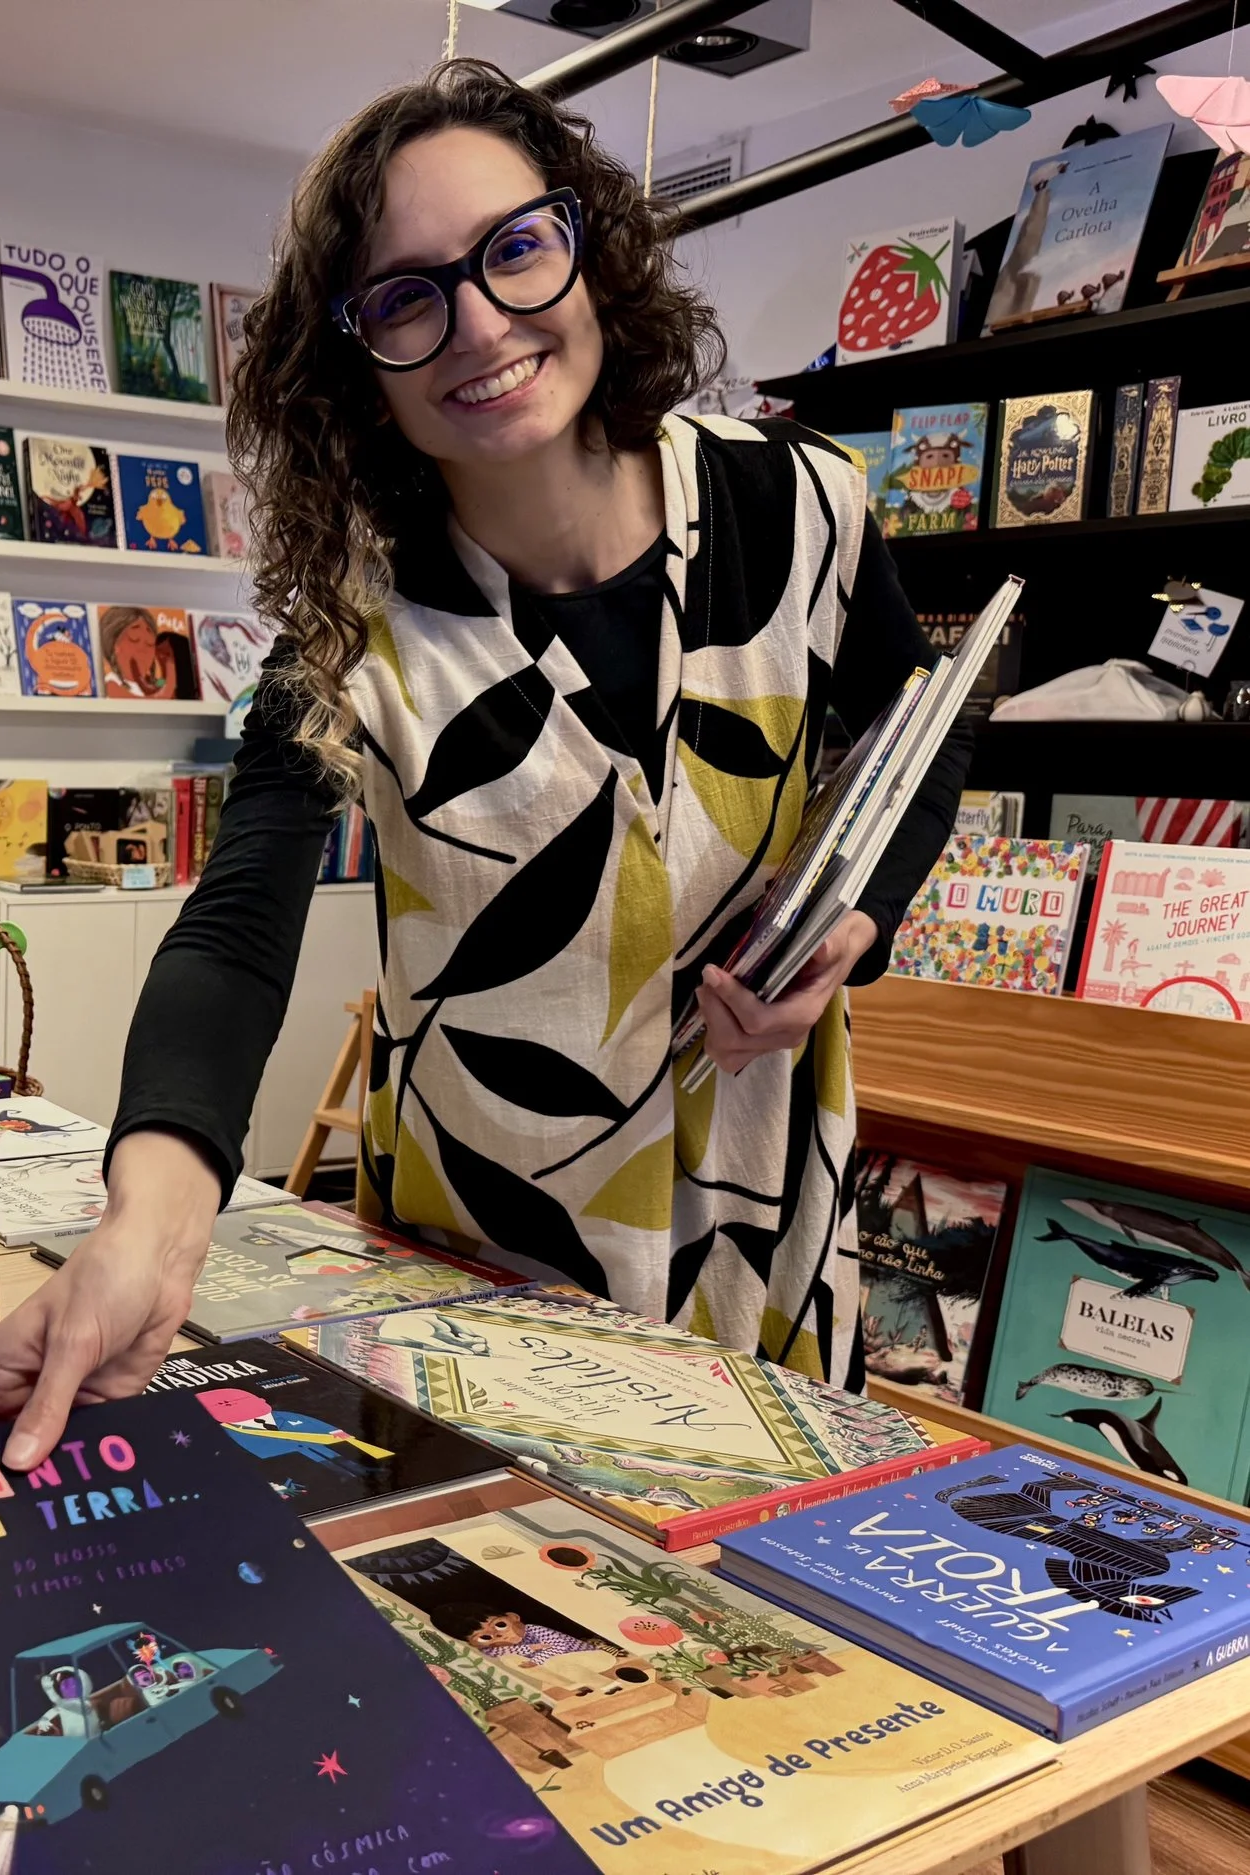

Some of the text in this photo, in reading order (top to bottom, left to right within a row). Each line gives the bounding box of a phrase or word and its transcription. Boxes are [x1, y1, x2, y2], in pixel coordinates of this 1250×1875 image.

[1088, 181, 1101, 196] A
[1062, 197, 1118, 223] Ovelha
[1054, 218, 1113, 245] Carlota
[3, 244, 90, 275] TUDO O
[58, 272, 99, 297] QUE
[911, 412, 970, 429] FLIP FLAP
[1208, 411, 1247, 427] LIVRO
[908, 465, 963, 488] SNAP!
[1012, 454, 1073, 480] Harry Potter
[908, 511, 955, 531] FARM
[1066, 813, 1104, 836] Para
[946, 882, 1065, 918] O MURO
[1163, 890, 1249, 920] THE GREAT
[1167, 913, 1240, 938] JOURNEY
[859, 1230, 928, 1260] o cão que
[877, 1253, 945, 1281] não tinha
[1078, 1300, 1175, 1342] BALEIAS
[1095, 1325, 1152, 1349] vida secreta
[142, 1359, 268, 1396] ITADURA
[155, 1358, 199, 1376] SSIM
[508, 1336, 752, 1432] Aristides
[522, 1373, 620, 1416] História
[36, 1479, 200, 1531] TERRA...
[54, 1542, 118, 1567] NOSSO
[760, 1537, 815, 1564] Johnson
[849, 1511, 1100, 1633] TROIA
[841, 1540, 1069, 1653] A GUERRA DE
[850, 1575, 906, 1605] Mariana
[936, 1617, 989, 1645] Schuff
[911, 1730, 996, 1767] Victor Santos
[588, 1696, 947, 1848] Um Amigo de Presente
[896, 1779, 925, 1794] Anna
[311, 1825, 410, 1868] CÓSMICA
